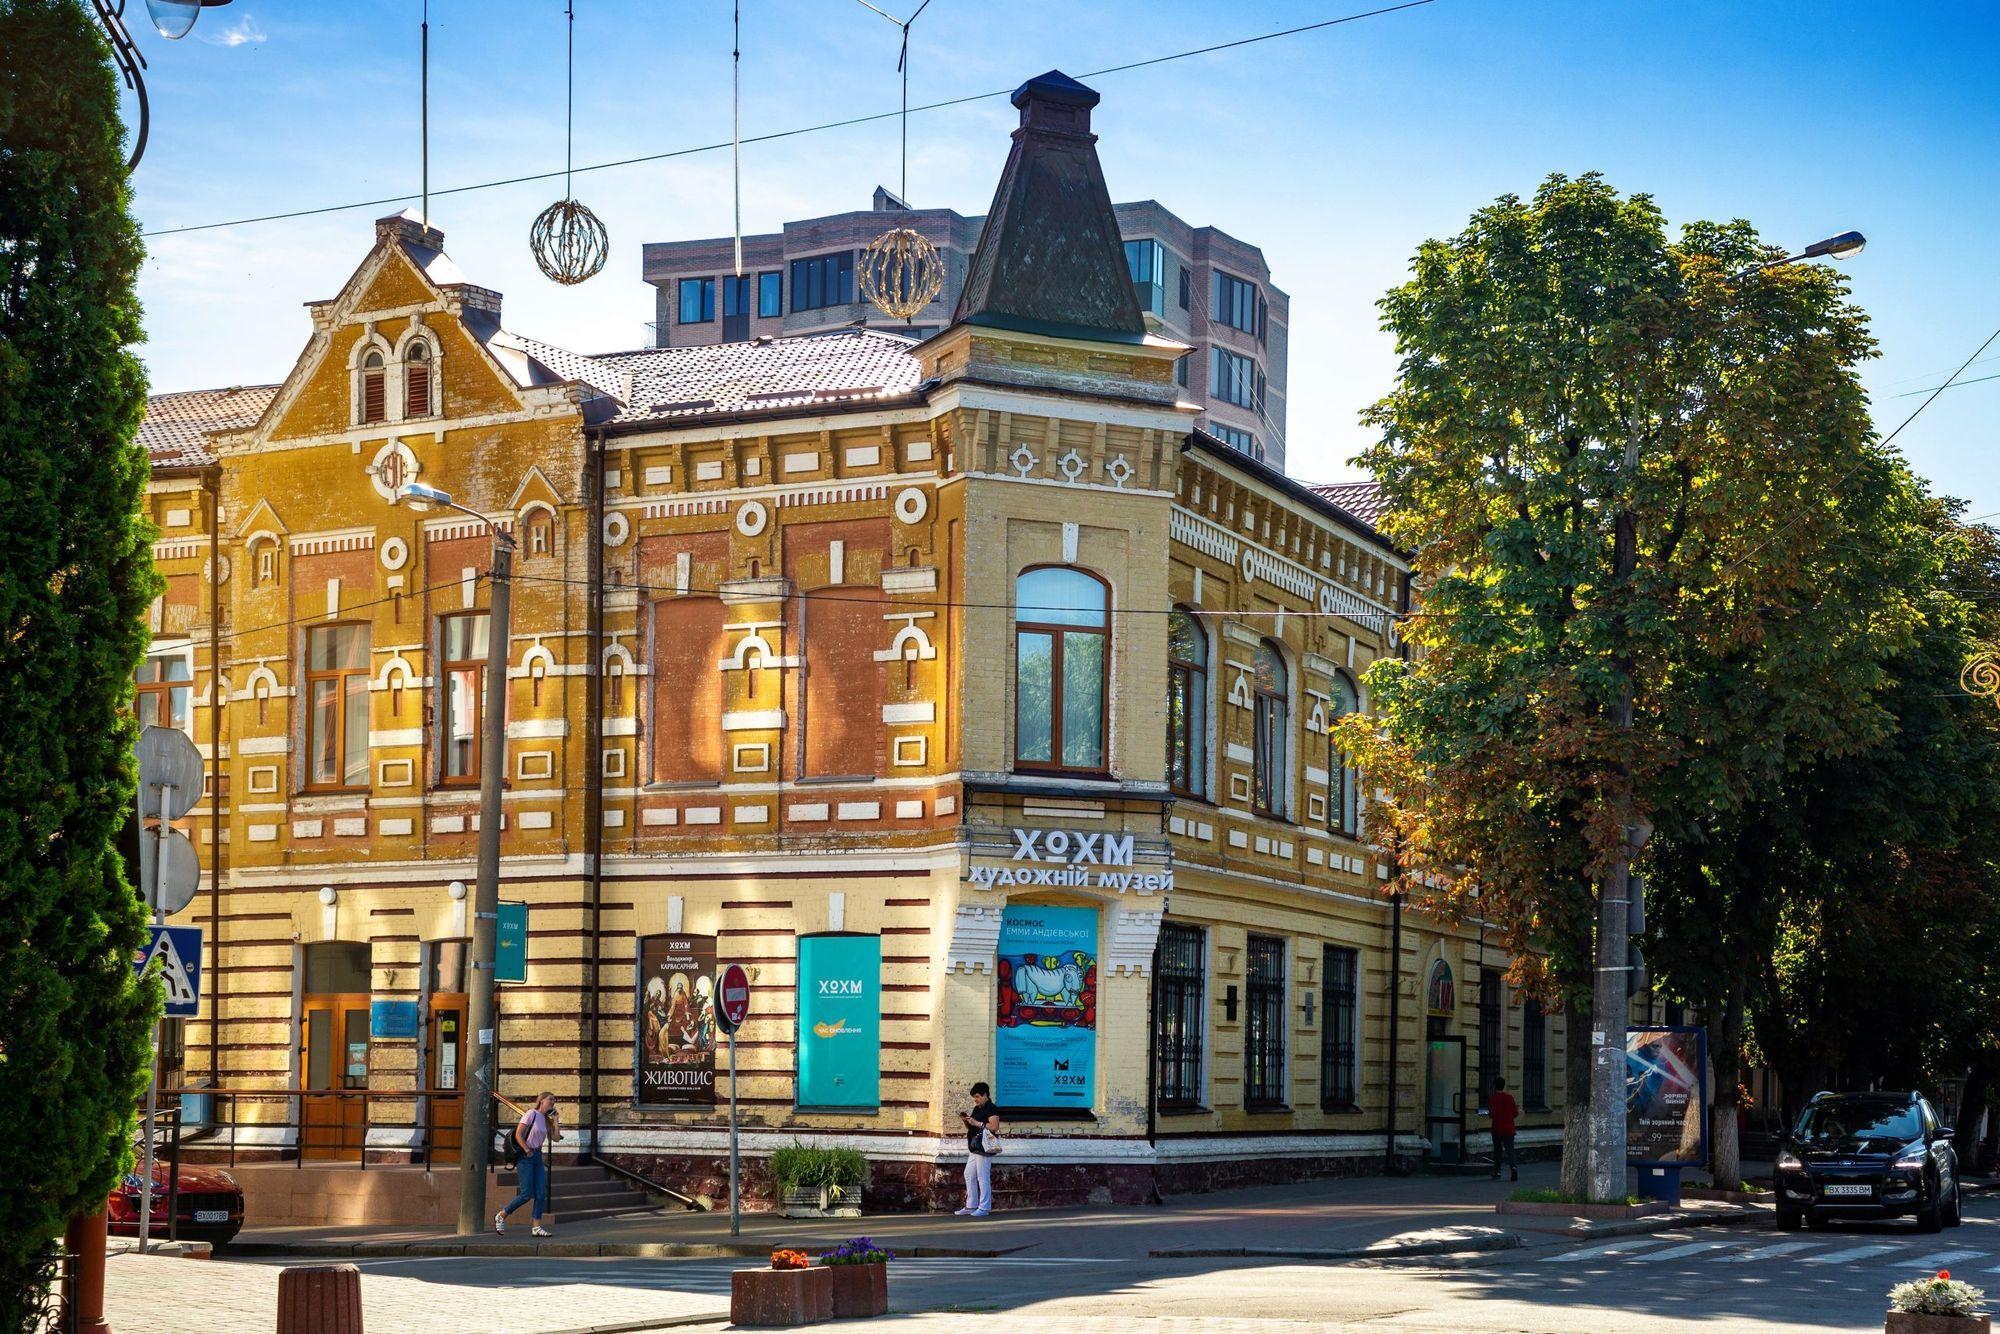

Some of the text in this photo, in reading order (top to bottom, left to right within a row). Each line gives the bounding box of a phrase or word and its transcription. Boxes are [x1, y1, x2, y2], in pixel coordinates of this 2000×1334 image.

[1012, 828, 1134, 866] ХОХМ
[968, 864, 1174, 894] художній музей
[1006, 919, 1045, 927] КОСМОС
[1006, 928, 1089, 938] ЕММИ АНДІЄВСЬКОЇ
[669, 941, 691, 949] ХОХМ
[818, 979, 863, 994] ХОХМ
[644, 1070, 713, 1086] ЖИВОПИС
[1054, 1075, 1086, 1085] ХОХМ
[1651, 1132, 1662, 1142] 99
[1841, 1186, 1858, 1194] 3335
